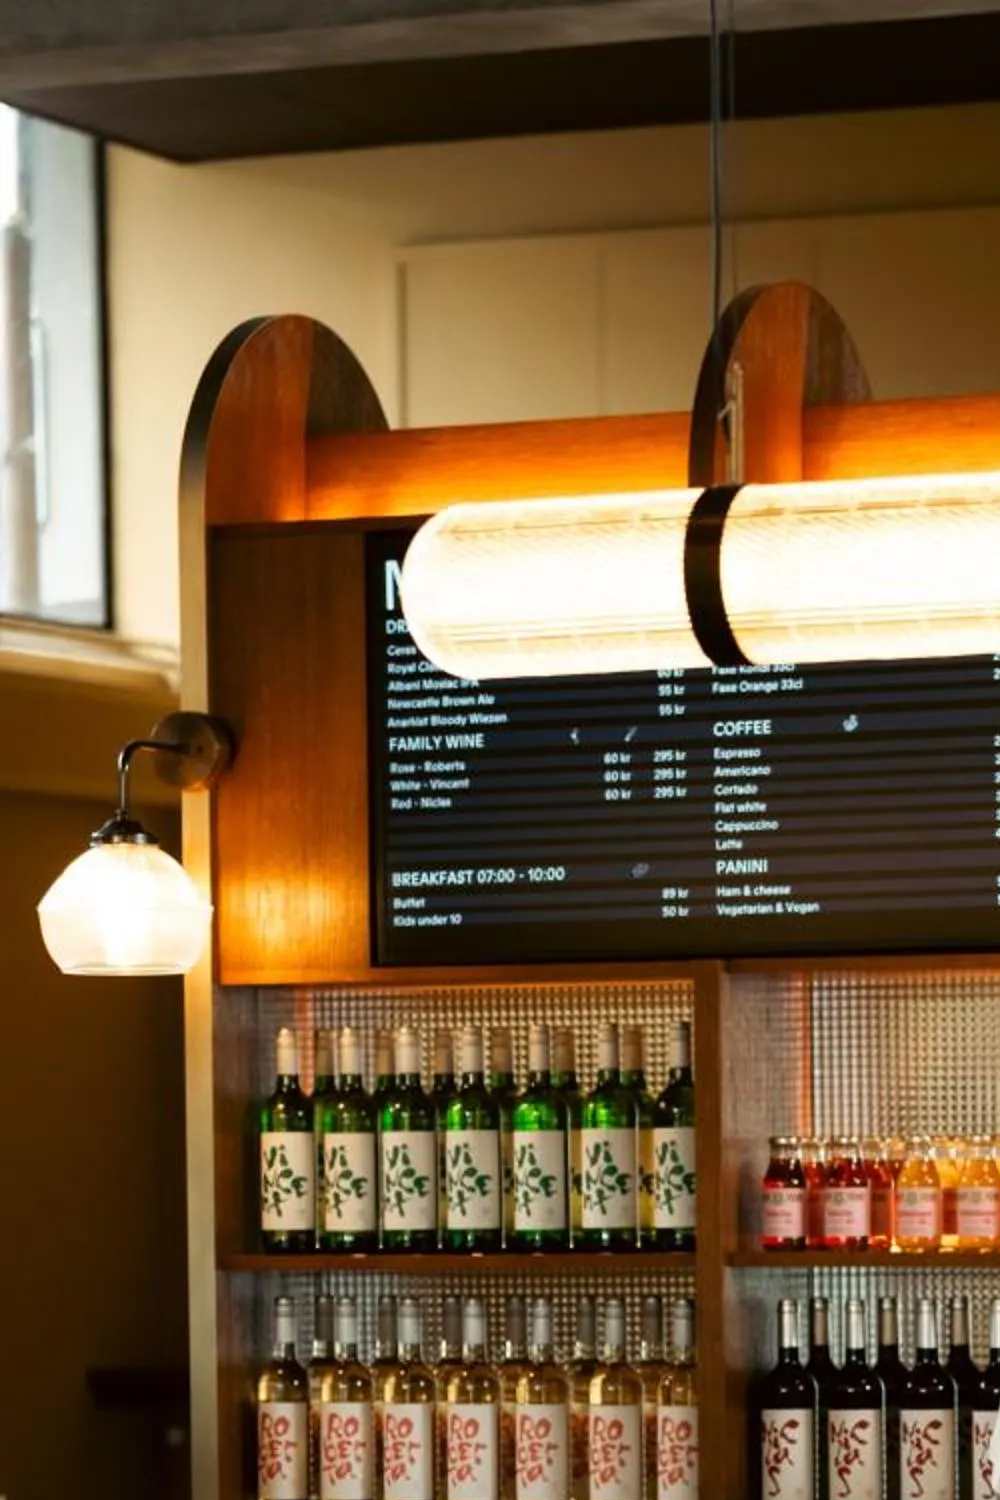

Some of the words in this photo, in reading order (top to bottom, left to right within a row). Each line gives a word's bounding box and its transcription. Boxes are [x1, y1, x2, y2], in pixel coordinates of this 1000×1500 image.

[673, 684, 686, 696] kr
[739, 680, 779, 694] Orange
[442, 695, 475, 708] Brown
[477, 692, 496, 706] Ale
[674, 703, 687, 716] kr
[713, 719, 772, 737] COFFEE
[389, 734, 443, 753] FAMILY
[445, 731, 485, 750] WINE
[620, 752, 632, 765] kr
[675, 749, 688, 762] kr
[713, 747, 761, 761] Espresso
[620, 770, 632, 782] kr
[675, 767, 688, 780] kr
[713, 765, 772, 778] Americano
[620, 788, 632, 800] kr
[675, 785, 688, 798] kr
[713, 783, 759, 797] Cortado
[714, 802, 735, 814] Flat
[736, 801, 767, 814] white
[714, 819, 780, 833] Cappuccino
[715, 858, 769, 876] PANINI
[391, 869, 475, 887] BREAKFAST
[476, 867, 516, 884] 07:00
[527, 866, 566, 882] 10:00
[677, 887, 690, 899] kr
[715, 885, 742, 898] Ham
[753, 884, 793, 897] cheese
[677, 905, 690, 917] kr
[715, 902, 774, 918] Vegetarian
[785, 900, 821, 916] Vegan
[417, 913, 448, 926] under
[449, 912, 463, 925] 10
